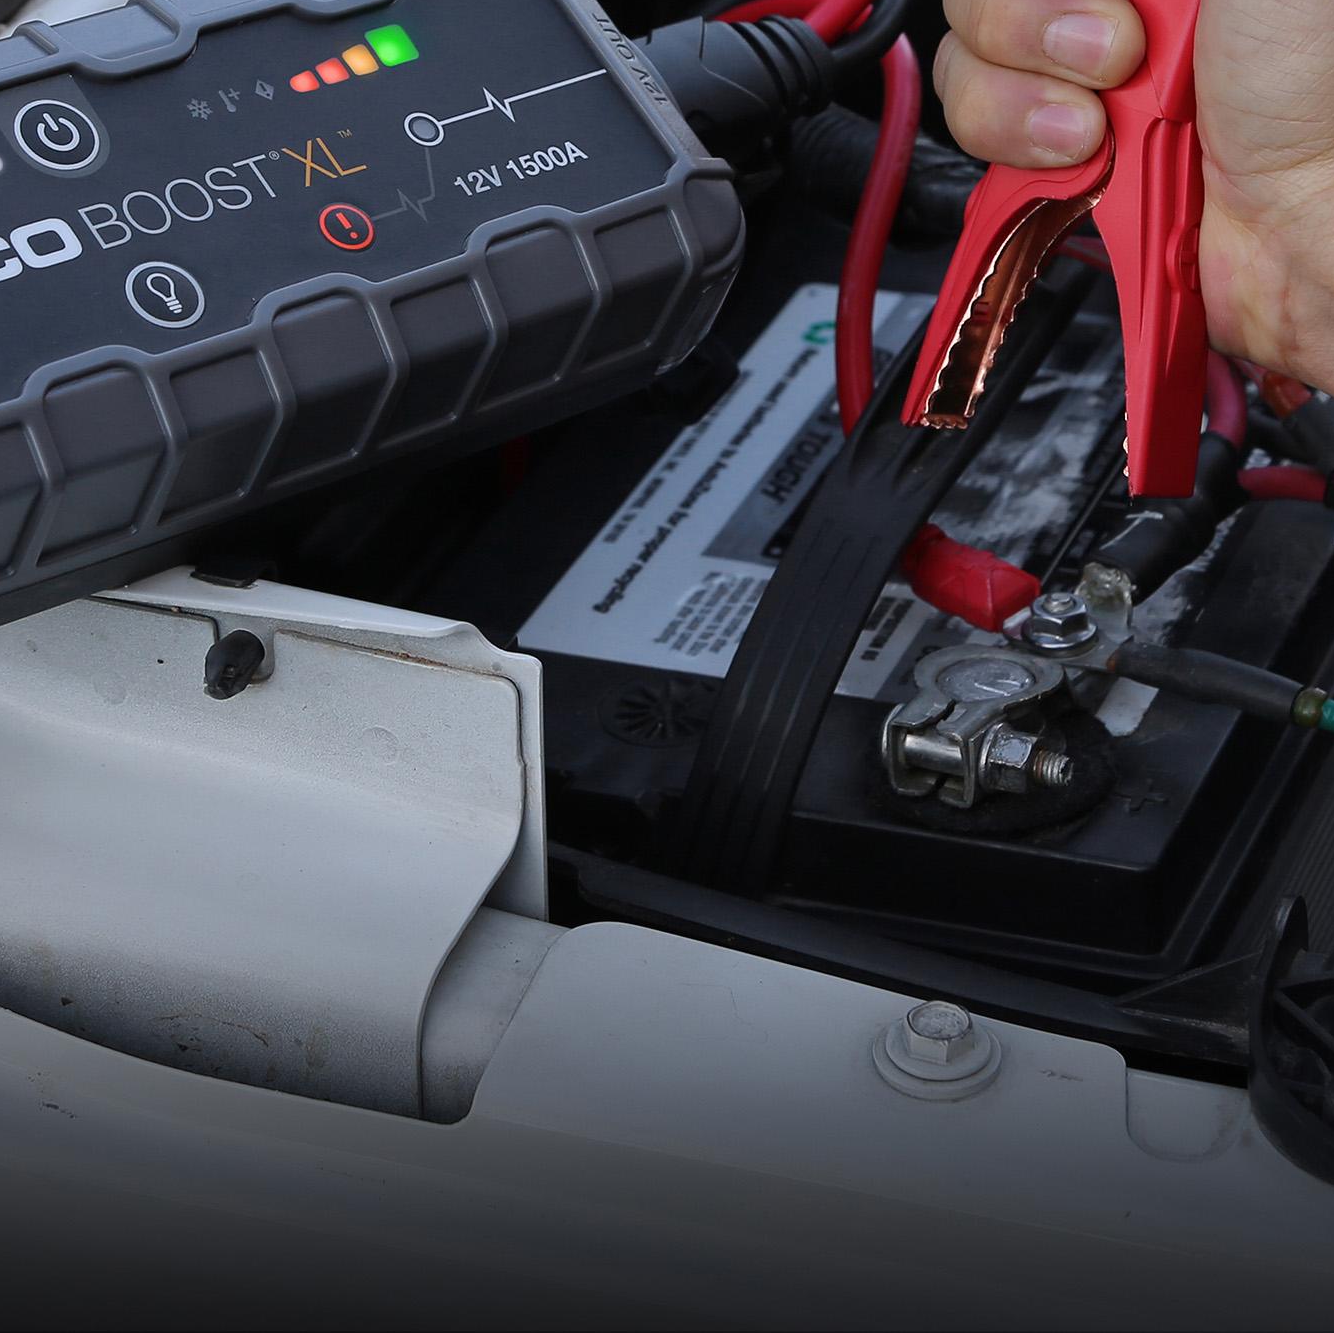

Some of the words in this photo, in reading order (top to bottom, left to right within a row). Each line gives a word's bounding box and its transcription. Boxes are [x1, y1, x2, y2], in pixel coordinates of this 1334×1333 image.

[592, 13, 635, 60] OUT
[453, 165, 503, 198] 12V
[505, 140, 589, 184] 1500A
[760, 430, 833, 505] TOUGH
